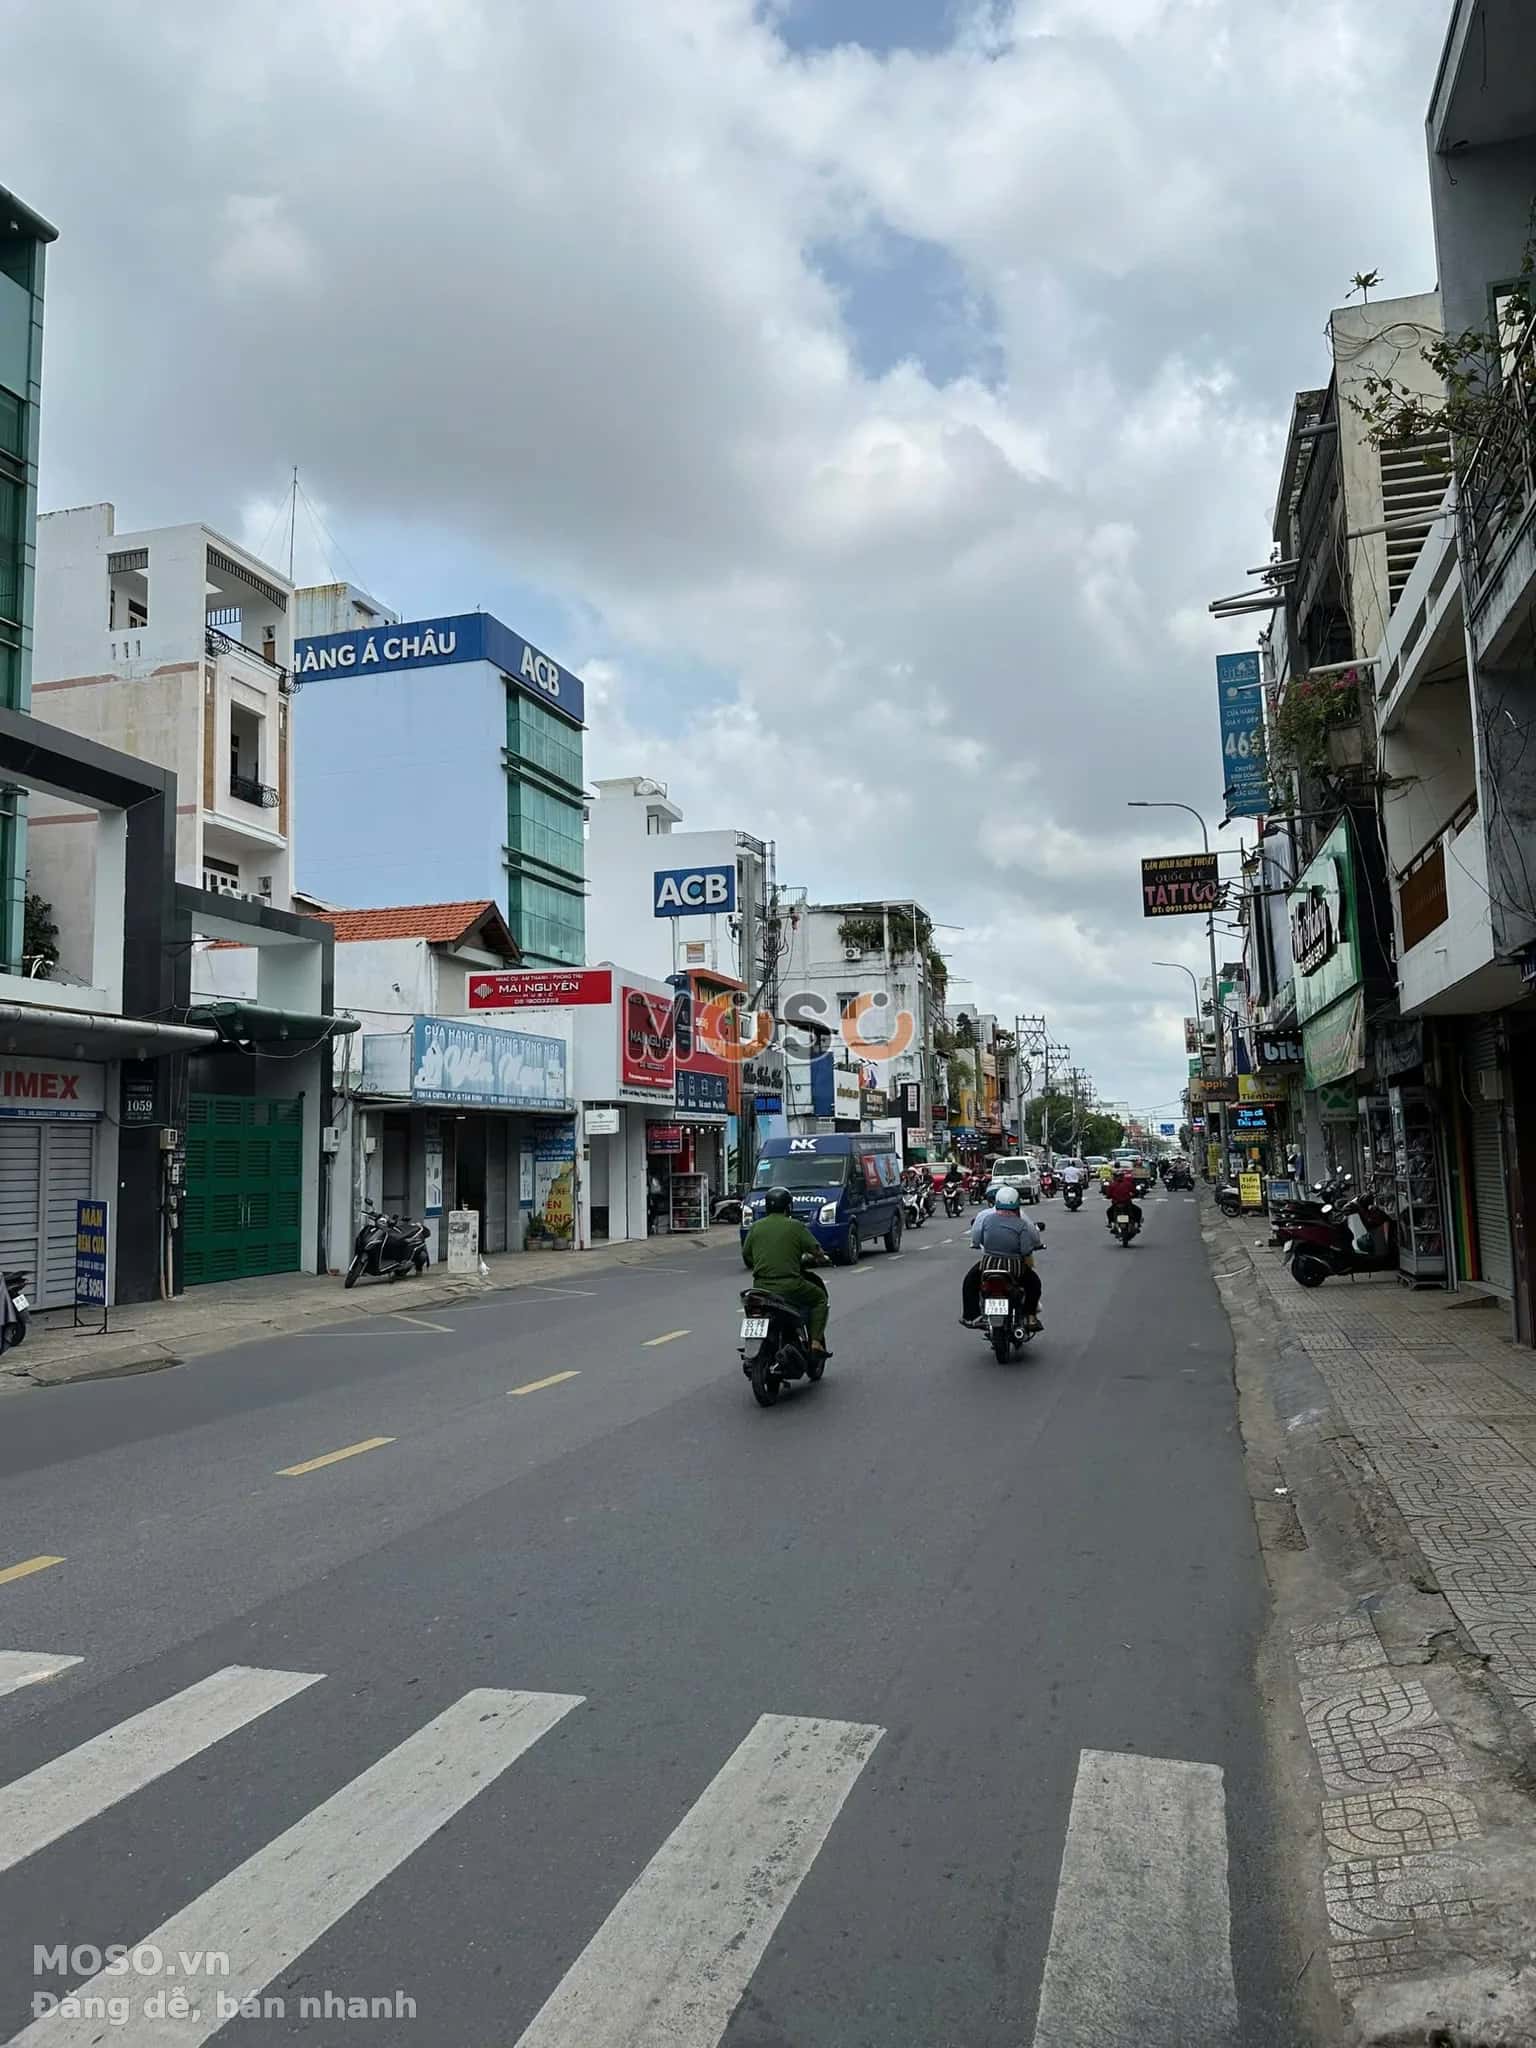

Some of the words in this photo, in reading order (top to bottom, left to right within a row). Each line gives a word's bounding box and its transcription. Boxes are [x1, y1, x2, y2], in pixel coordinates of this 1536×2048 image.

[362, 637, 379, 663] Á
[383, 628, 457, 660] CHÂU
[520, 646, 560, 697] ACB
[656, 874, 728, 908] ACB
[1144, 879, 1217, 906] TATTOO
[499, 984, 521, 993] MAI
[0, 1071, 80, 1099] IMEX
[1200, 1080, 1227, 1090] Apple
[127, 1099, 153, 1111] 1059
